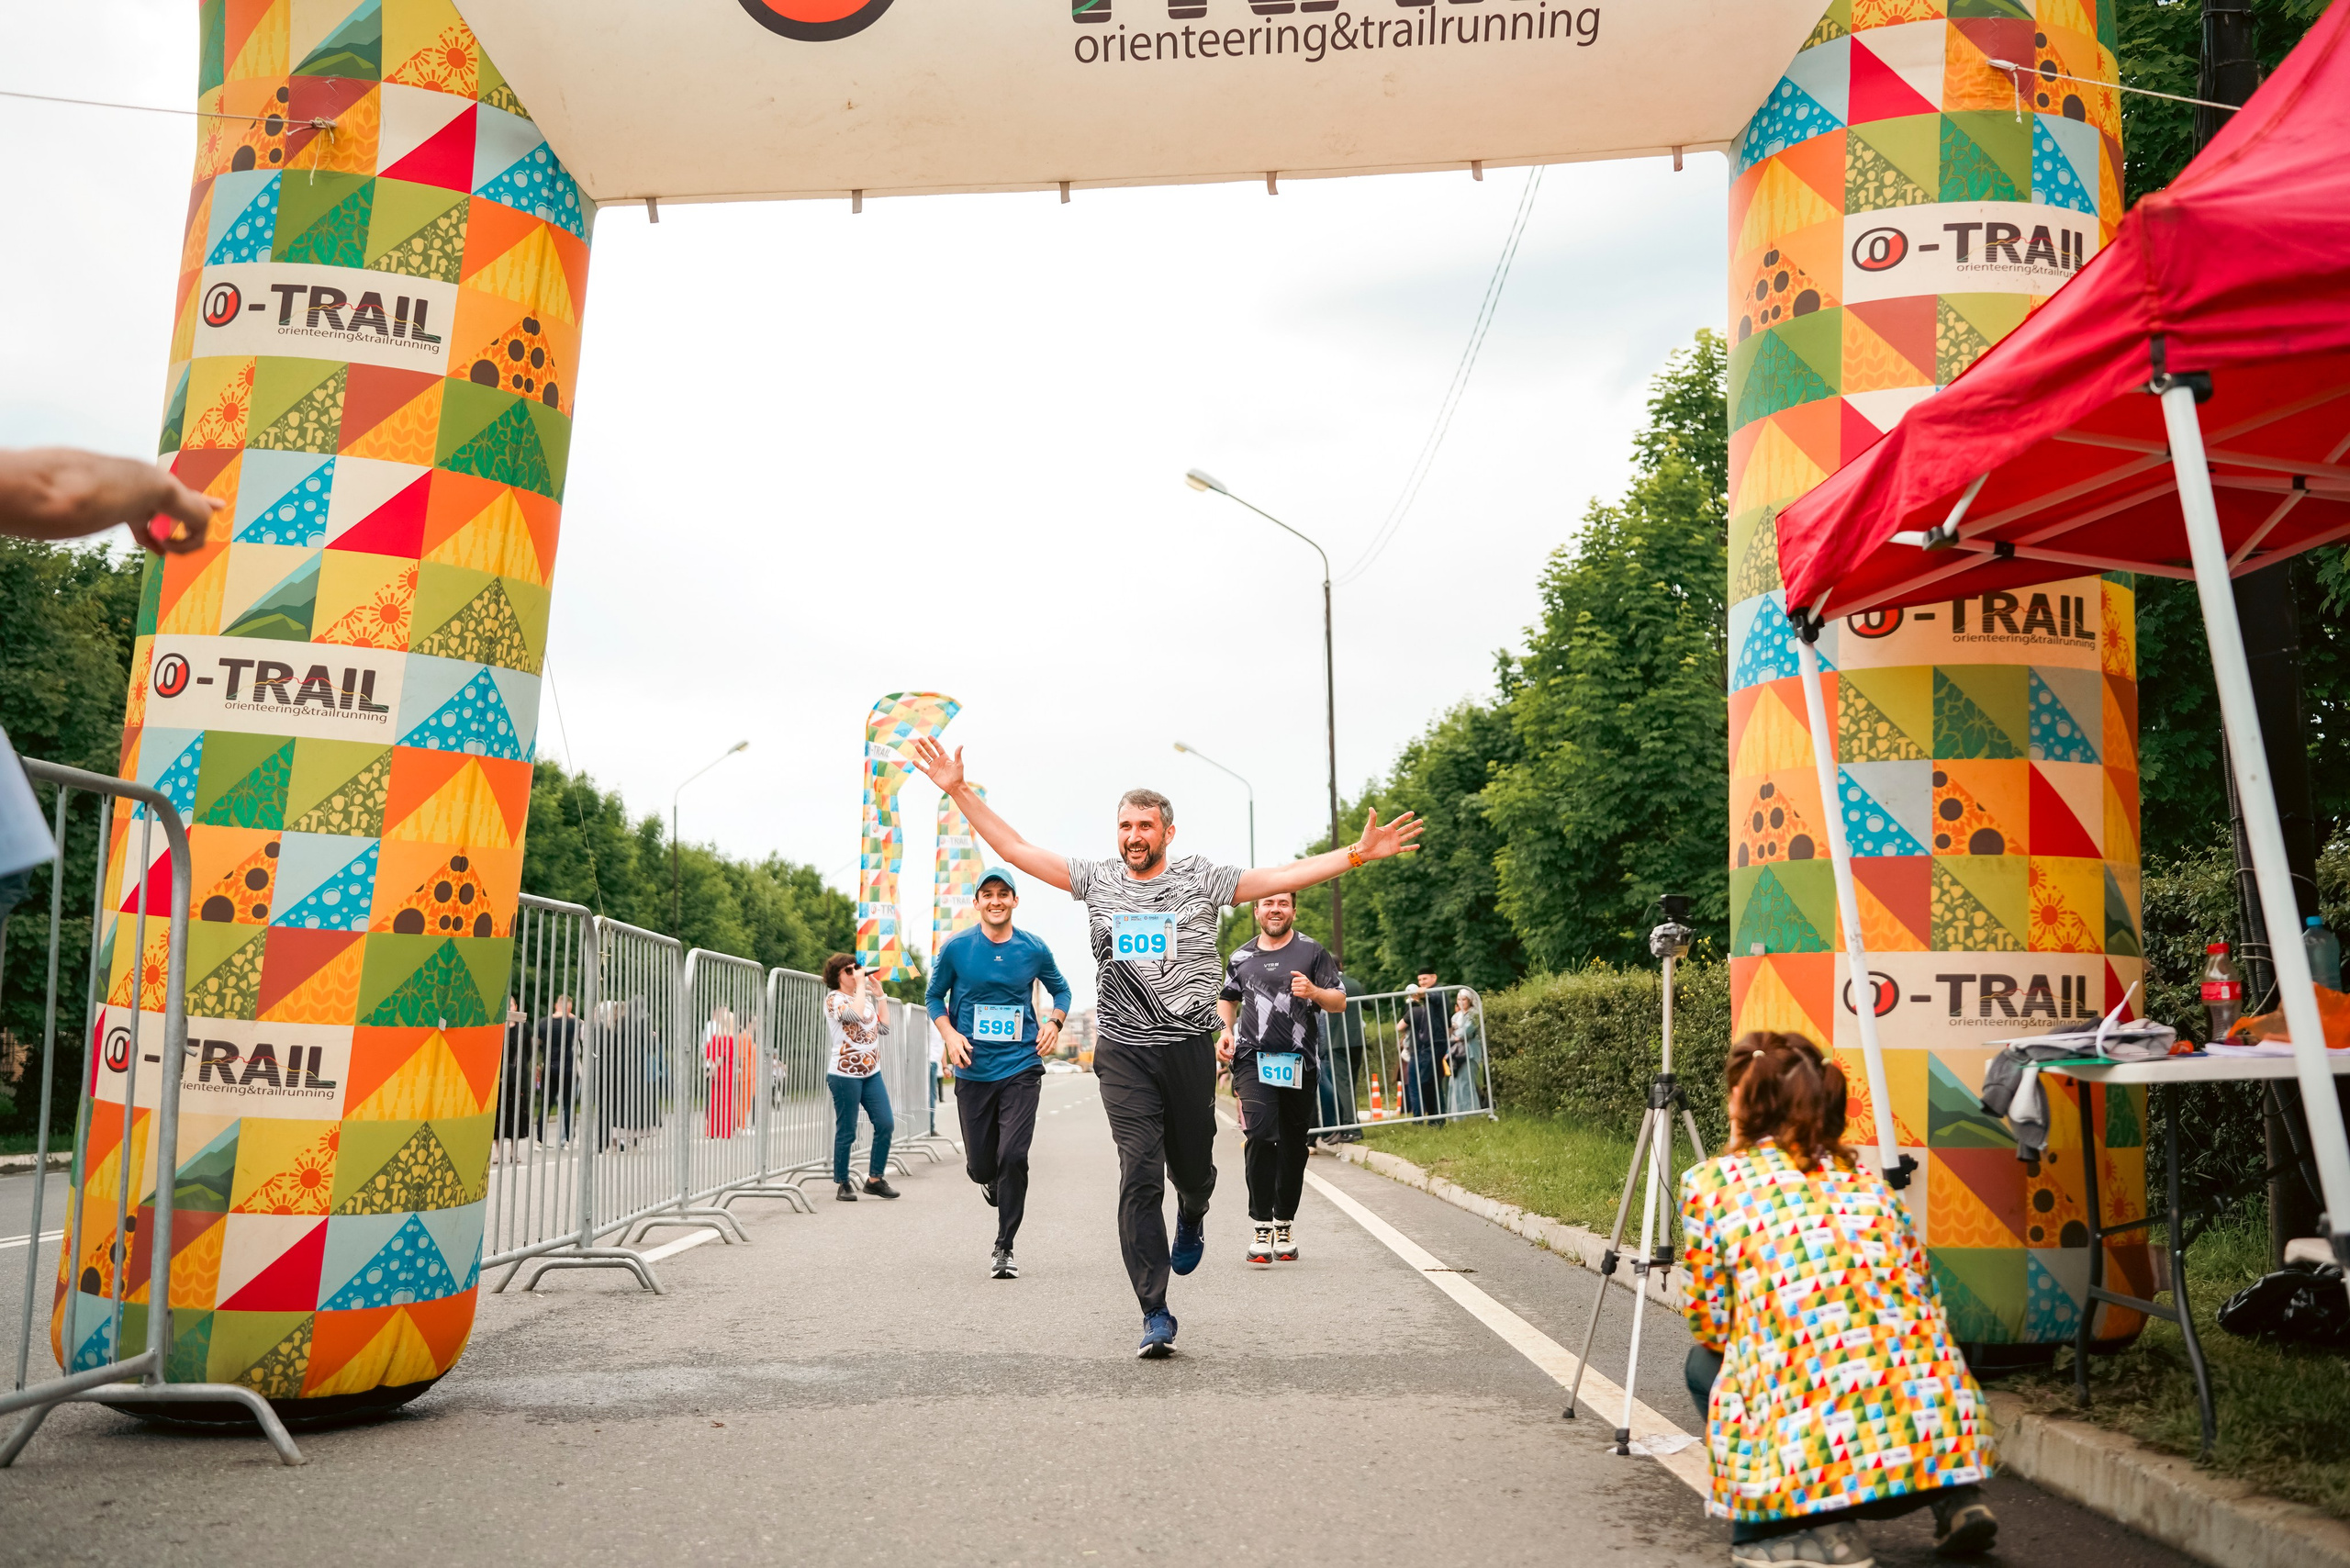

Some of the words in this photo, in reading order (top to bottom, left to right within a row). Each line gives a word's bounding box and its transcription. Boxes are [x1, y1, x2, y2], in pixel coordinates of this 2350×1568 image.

[1074, 3, 1601, 63] orienteering&trailrunning
[277, 326, 441, 355] orienteering&trailrunning
[1953, 633, 2097, 651] orienteering&trailrunning
[225, 700, 388, 724] orienteering&trailrunning
[1118, 934, 1167, 954] 609
[979, 1020, 1015, 1036] 598
[1262, 1066, 1292, 1081] 610
